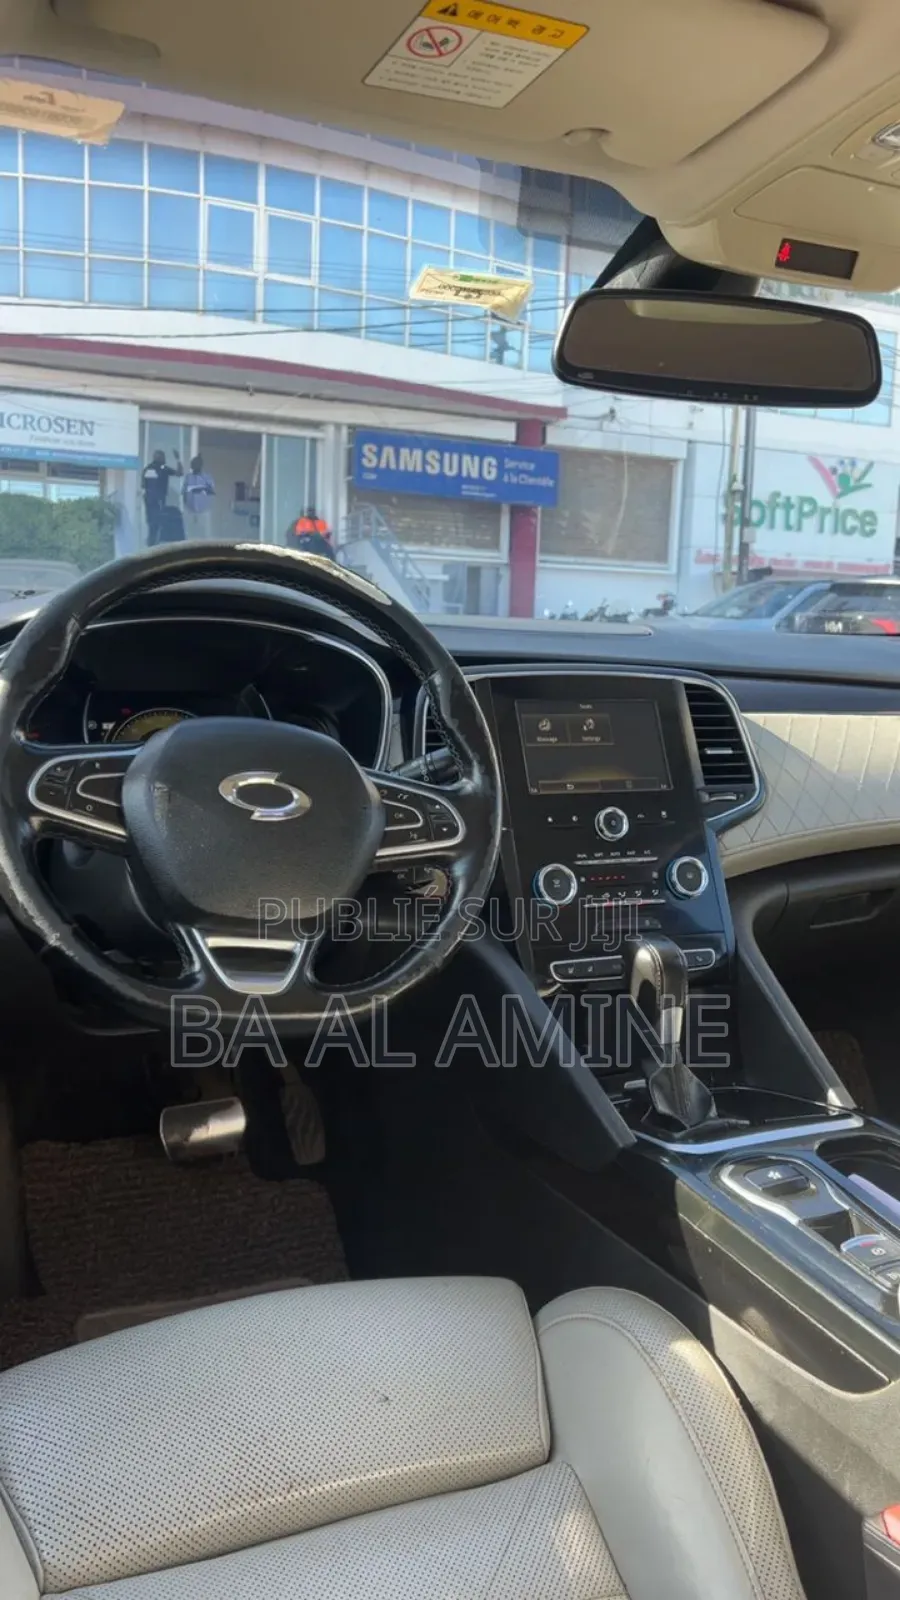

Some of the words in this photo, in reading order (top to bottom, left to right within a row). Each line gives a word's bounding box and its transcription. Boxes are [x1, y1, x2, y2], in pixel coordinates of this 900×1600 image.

[361, 443, 498, 481] SAMSUNG
[503, 457, 536, 472] Service
[510, 472, 518, 484] la
